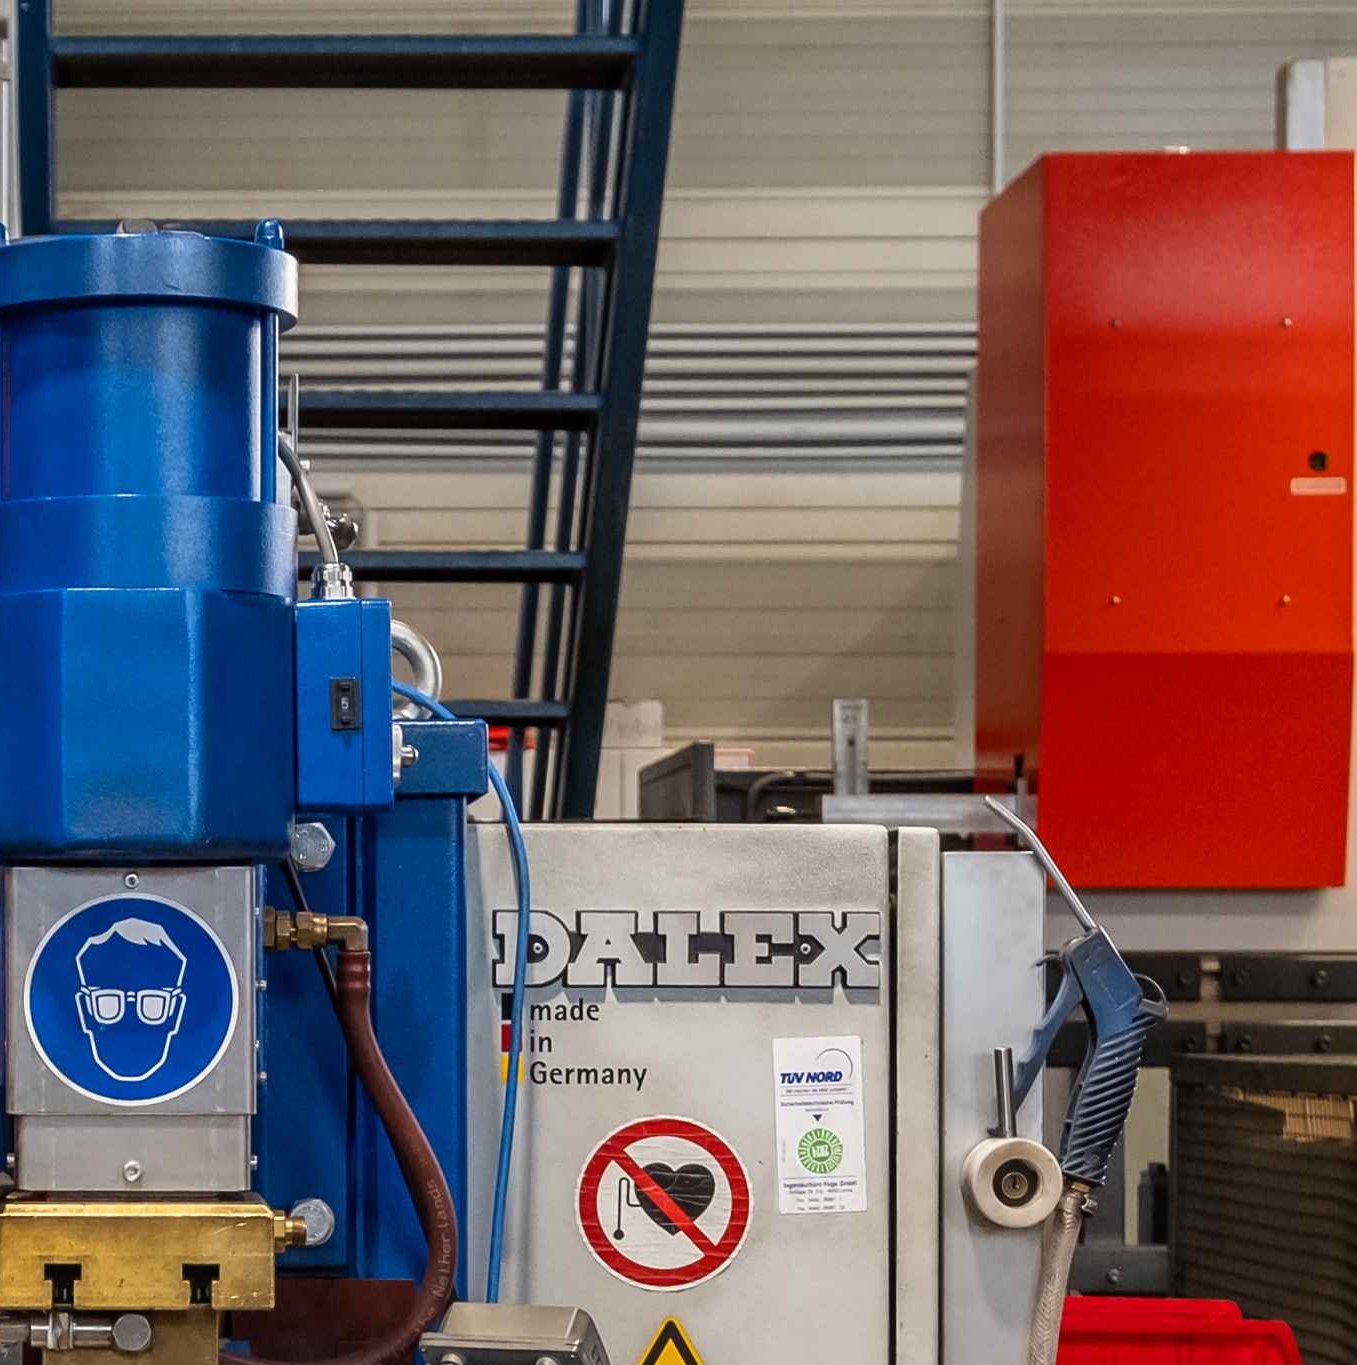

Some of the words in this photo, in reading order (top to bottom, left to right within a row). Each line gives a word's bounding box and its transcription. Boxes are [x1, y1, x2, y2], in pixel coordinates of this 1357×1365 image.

[340, 697, 349, 710] 5
[492, 910, 881, 989] DALEX
[529, 998, 600, 1022] made
[529, 1030, 553, 1053] in
[529, 1061, 648, 1091] Germany
[805, 1071, 843, 1083] NORD
